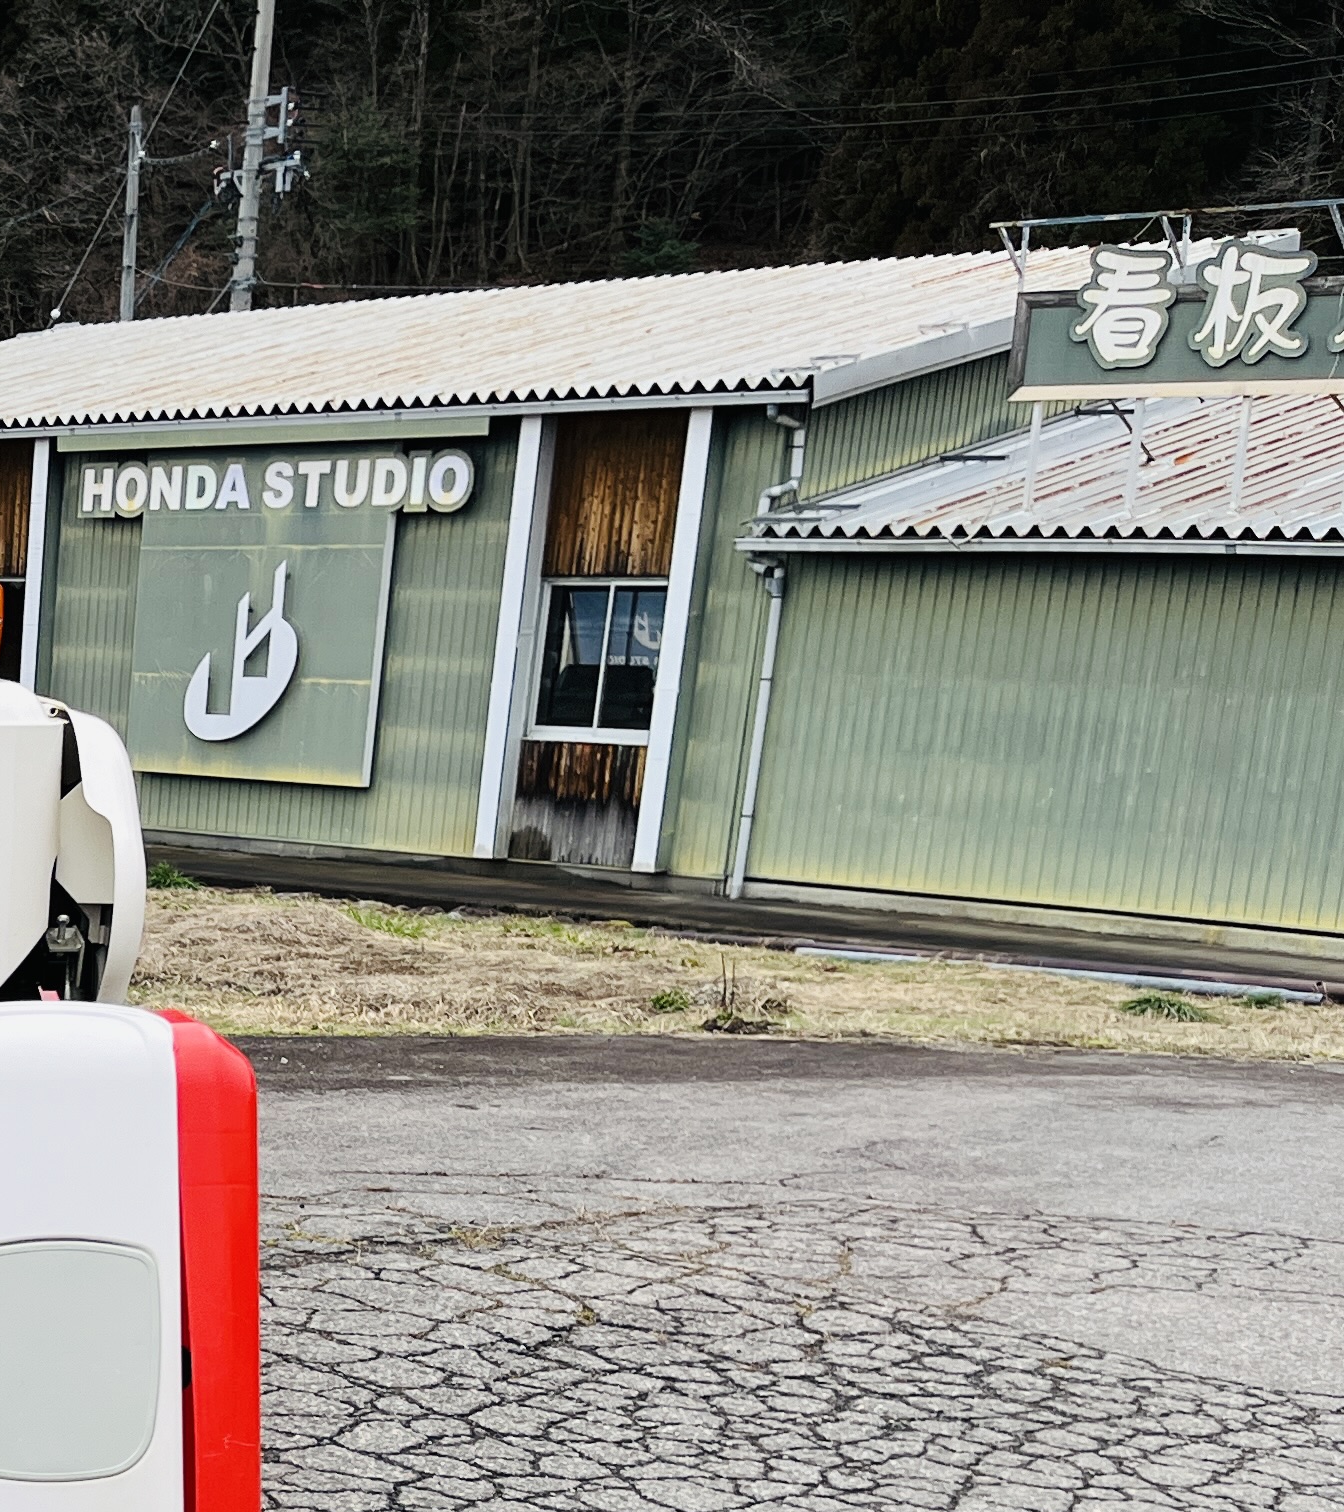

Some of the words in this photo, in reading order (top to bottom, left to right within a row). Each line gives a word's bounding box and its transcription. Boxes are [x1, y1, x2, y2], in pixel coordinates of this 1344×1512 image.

[1075, 246, 1344, 361] 看板
[81, 463, 250, 513] HONDA
[262, 455, 472, 510] STUDIO
